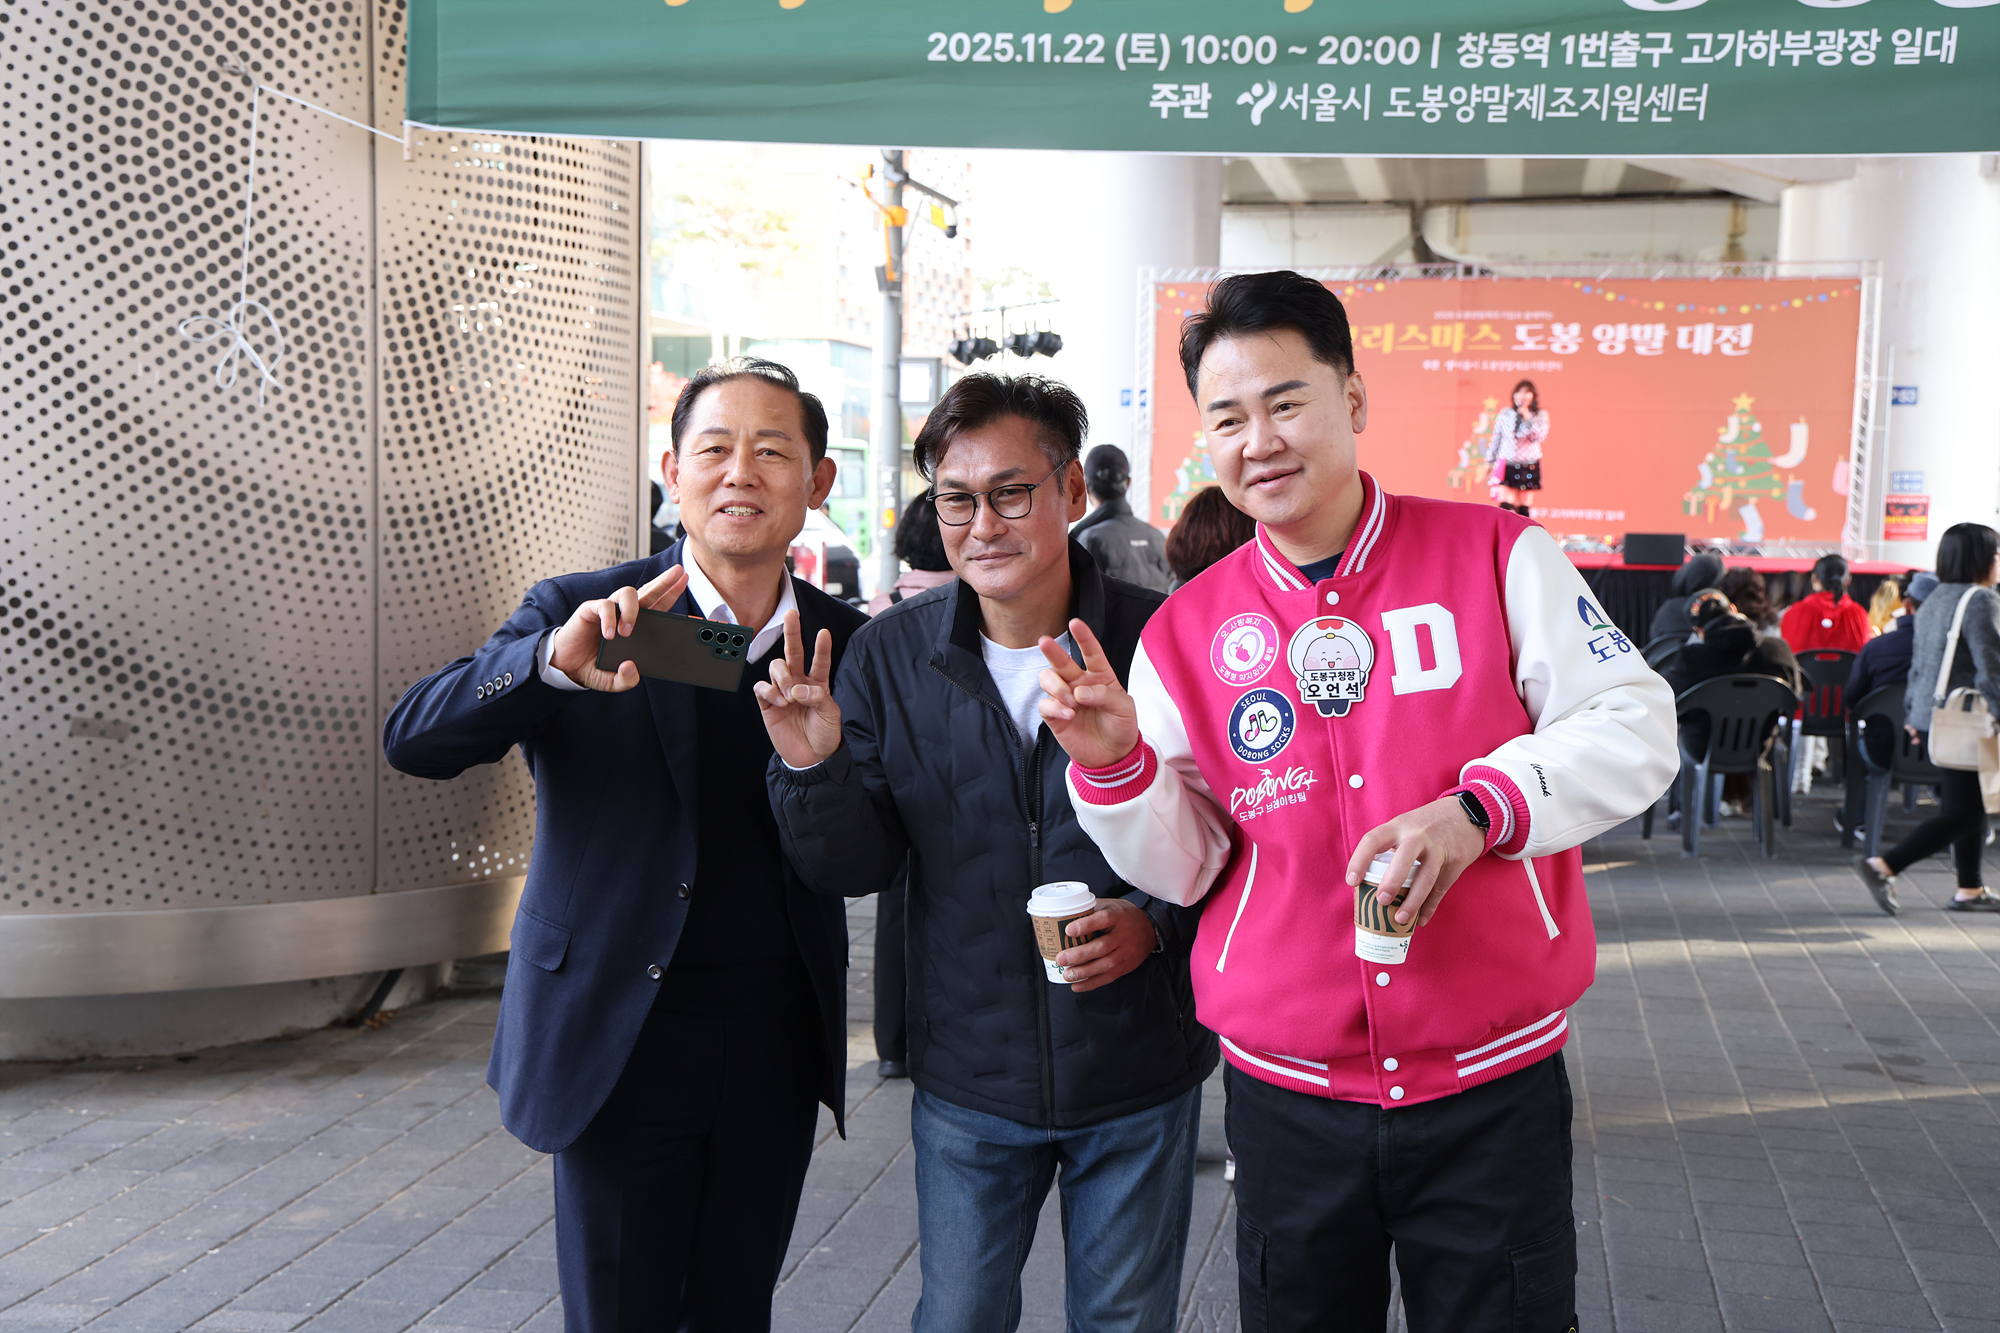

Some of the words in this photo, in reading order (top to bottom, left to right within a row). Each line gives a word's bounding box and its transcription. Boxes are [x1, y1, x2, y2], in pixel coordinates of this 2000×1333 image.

[927, 31, 1106, 64] 2025.11.22
[1115, 32, 1171, 72] (토)
[1181, 34, 1278, 65] 10:00
[1317, 35, 1421, 66] 20:00
[1456, 31, 1551, 69] 창동역
[1560, 30, 1674, 68] 1번출구
[1681, 27, 1883, 67] 고가하부광장
[1891, 27, 1959, 65] 일대
[1149, 82, 1213, 120] 주관
[1278, 82, 1371, 123] 서울시
[1382, 82, 1709, 124] 도봉양말제조지원센터
[1349, 321, 1504, 355] 리스마스
[1510, 321, 1585, 356] 도봉
[1592, 321, 1670, 357] 양말
[1676, 321, 1754, 357] 대전
[1380, 602, 1464, 696] D
[1587, 629, 1631, 664] 도봉
[1310, 671, 1356, 682] 도봉구청장
[1240, 692, 1267, 710] SEOUL
[1237, 745, 1270, 760] DOBONG
[1270, 726, 1291, 753] SOCKS
[1238, 806, 1265, 823] 도봉구
[1265, 791, 1307, 814] 브레이킹팀
